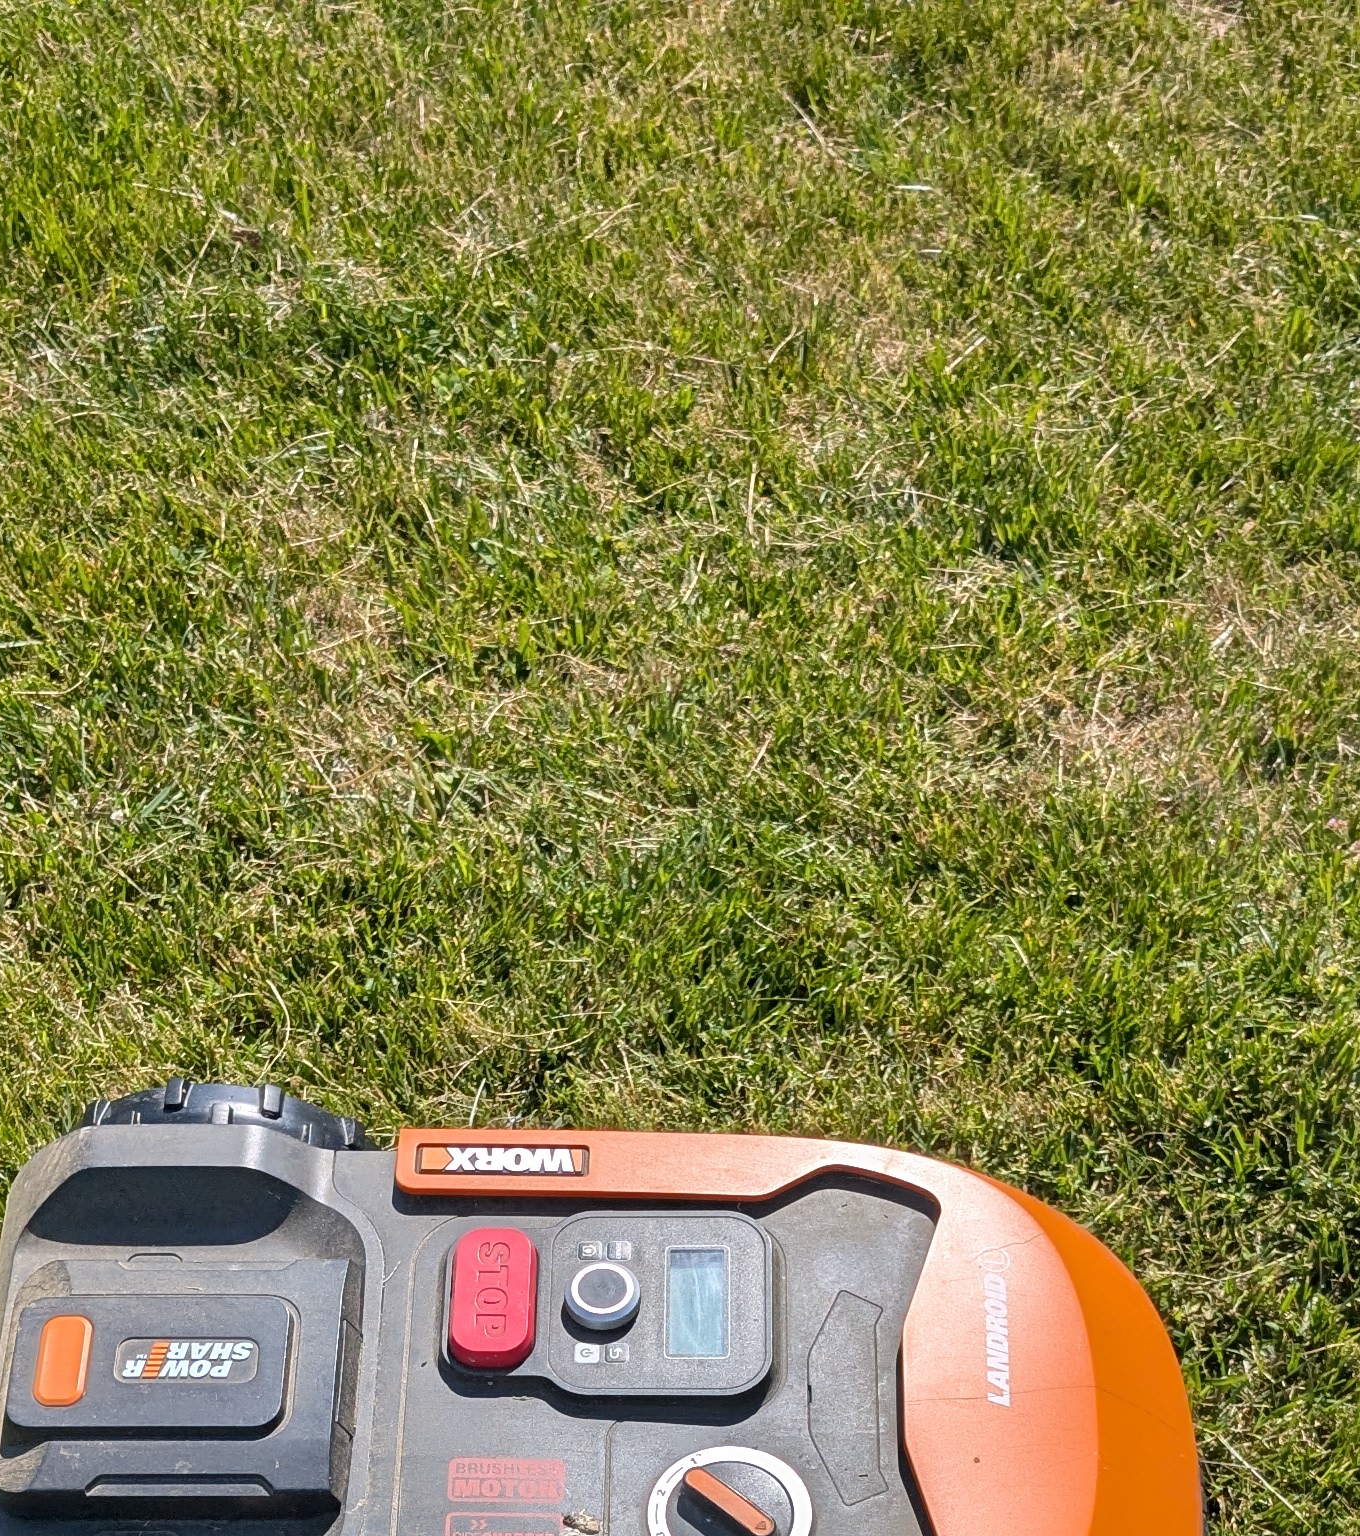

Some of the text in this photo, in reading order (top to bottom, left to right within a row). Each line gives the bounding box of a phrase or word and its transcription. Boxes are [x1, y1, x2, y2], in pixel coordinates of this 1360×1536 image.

[443, 1147, 575, 1172] WORX
[474, 1241, 511, 1338] STOP
[984, 1274, 1010, 1407] LANDROID
[152, 1341, 253, 1360] SHARE
[122, 1360, 233, 1378] POWER
[453, 1479, 559, 1498] MOTOR
[657, 1489, 666, 1497] 2
